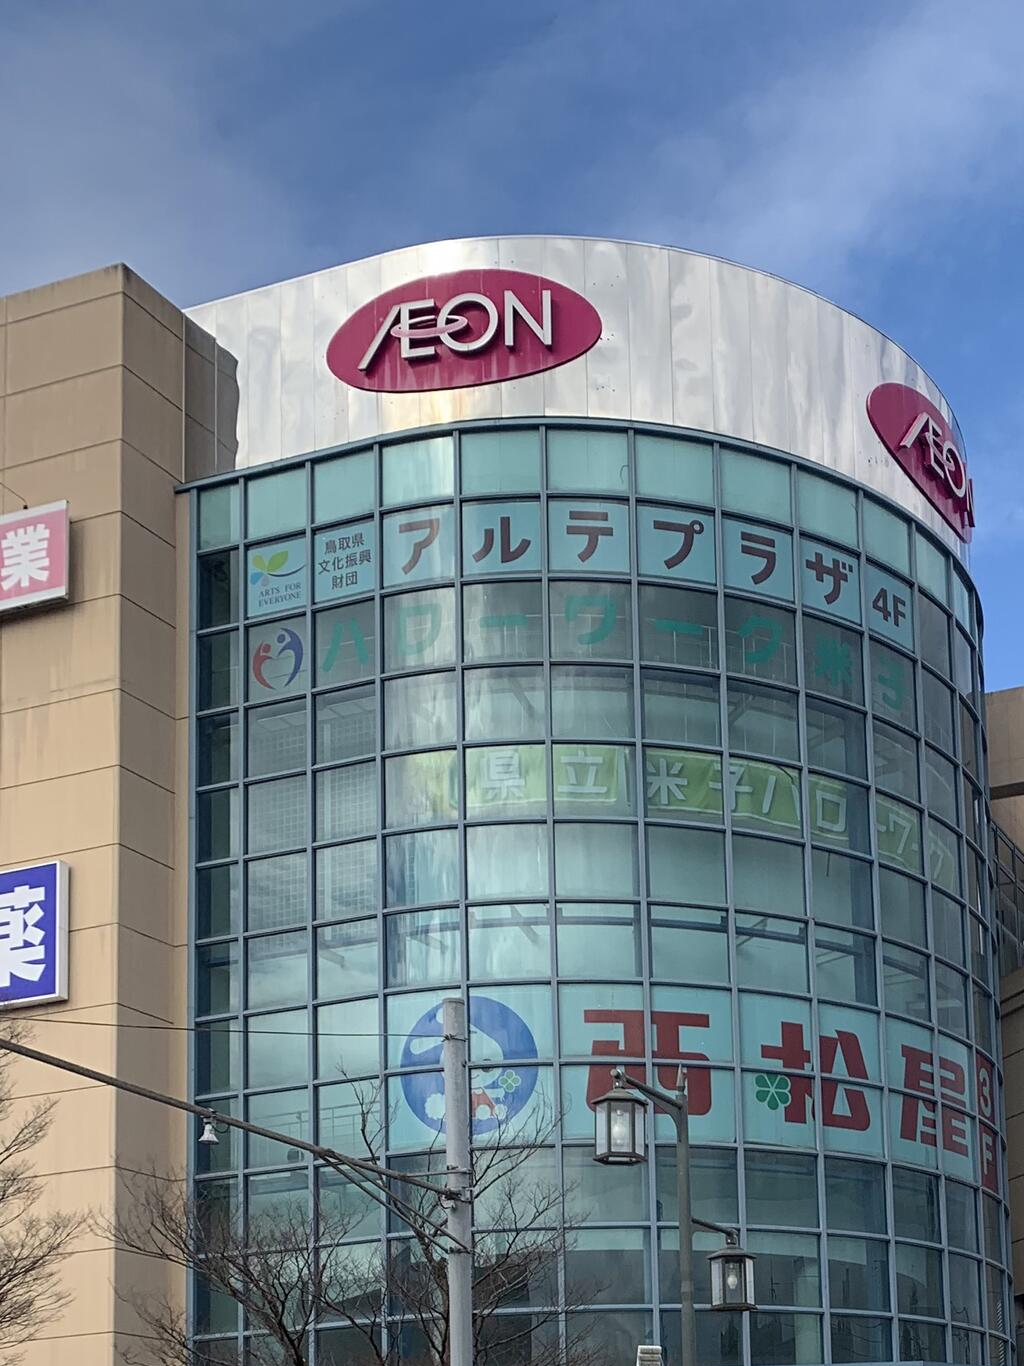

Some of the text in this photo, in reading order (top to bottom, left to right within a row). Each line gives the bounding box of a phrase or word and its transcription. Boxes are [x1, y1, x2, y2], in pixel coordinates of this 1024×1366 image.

[324, 532, 365, 554] 鳥取県
[0, 524, 50, 591] 業
[318, 548, 372, 575] 文化振興
[399, 510, 906, 627] アルテプラザ 4F
[258, 582, 301, 598] ARTS FOR
[331, 570, 358, 590] 財団
[258, 590, 302, 608] EVERYONE
[584, 1009, 968, 1157] 西松屋
